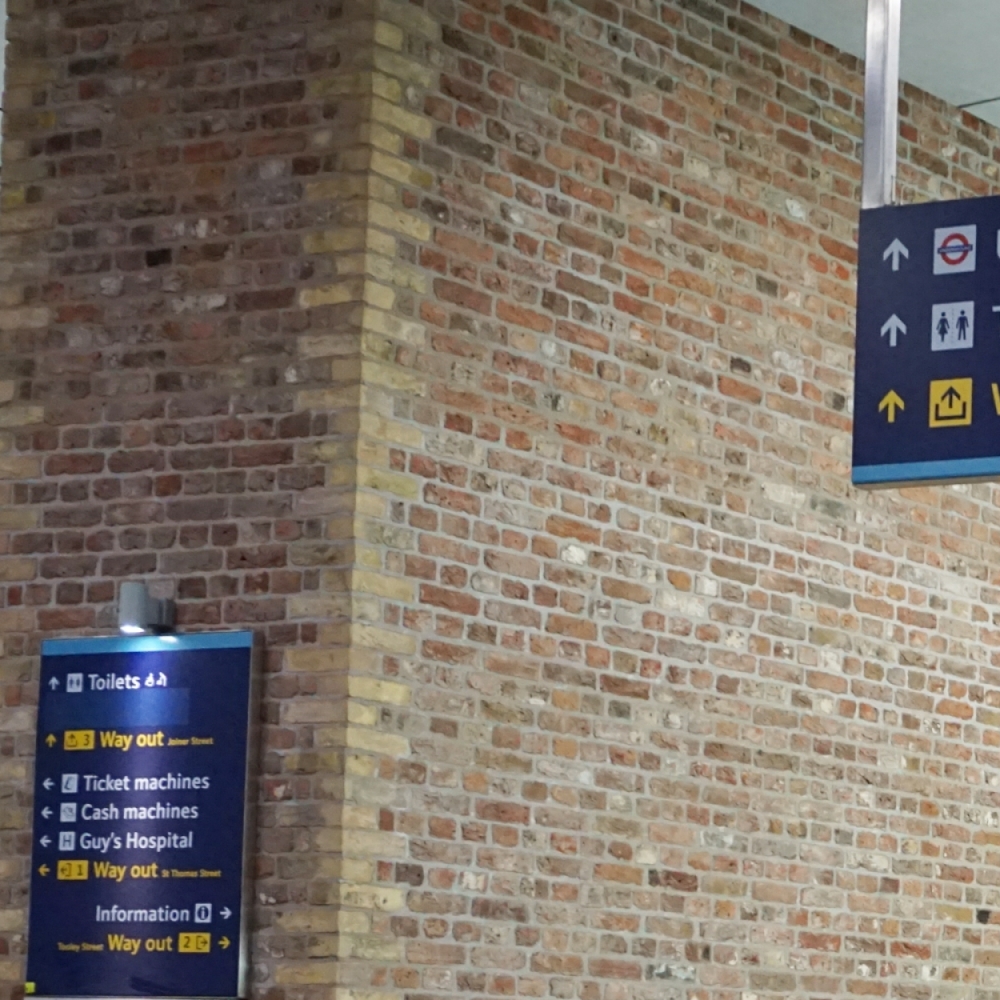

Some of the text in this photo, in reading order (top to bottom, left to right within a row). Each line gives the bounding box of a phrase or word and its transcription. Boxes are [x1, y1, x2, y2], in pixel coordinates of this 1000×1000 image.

[88, 673, 141, 690] Toilets
[83, 730, 214, 751] 3 Way out Joiner Street
[83, 773, 210, 791] Ticket machines
[81, 802, 199, 820] Cash machines
[79, 832, 122, 853] Guy's
[126, 831, 193, 852] Hospital
[77, 865, 83, 876] 1
[93, 861, 127, 882] Way
[130, 862, 158, 878] out
[171, 870, 198, 878] Thomas
[199, 869, 222, 878] Street
[96, 905, 190, 922] Information
[81, 942, 104, 951] Street
[107, 934, 141, 955] Way
[145, 936, 173, 951] out
[183, 936, 191, 948] 2
